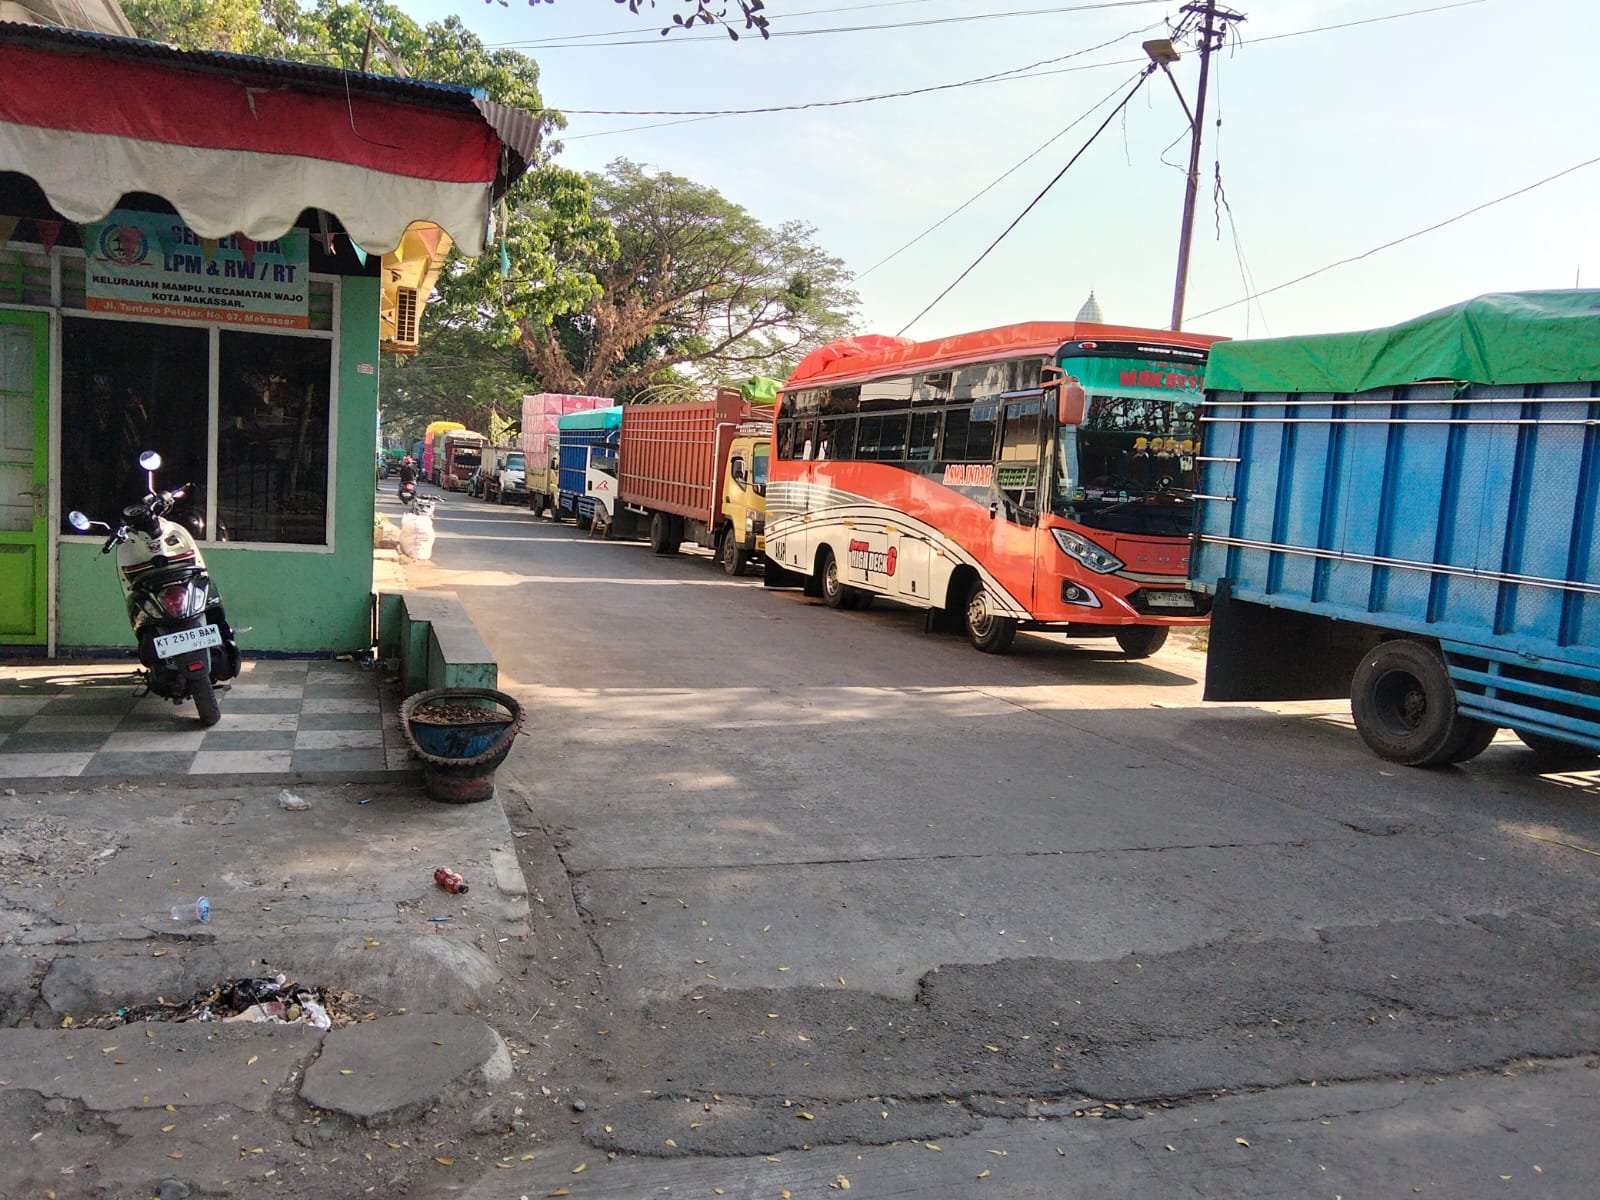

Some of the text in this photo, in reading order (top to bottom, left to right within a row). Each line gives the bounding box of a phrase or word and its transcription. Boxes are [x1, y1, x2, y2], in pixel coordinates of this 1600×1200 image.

[164, 253, 201, 275] LPM
[206, 260, 220, 277] &
[224, 259, 256, 279] RW
[273, 263, 297, 283] RT
[92, 275, 159, 289] KELURAHAN
[208, 286, 272, 299] KECAMATAN
[274, 292, 304, 302] WAJO
[152, 292, 245, 308] KOTA MAKASSAR.
[1119, 369, 1204, 392] MAKASS
[156, 638, 169, 648] KT
[172, 631, 196, 643] 2516
